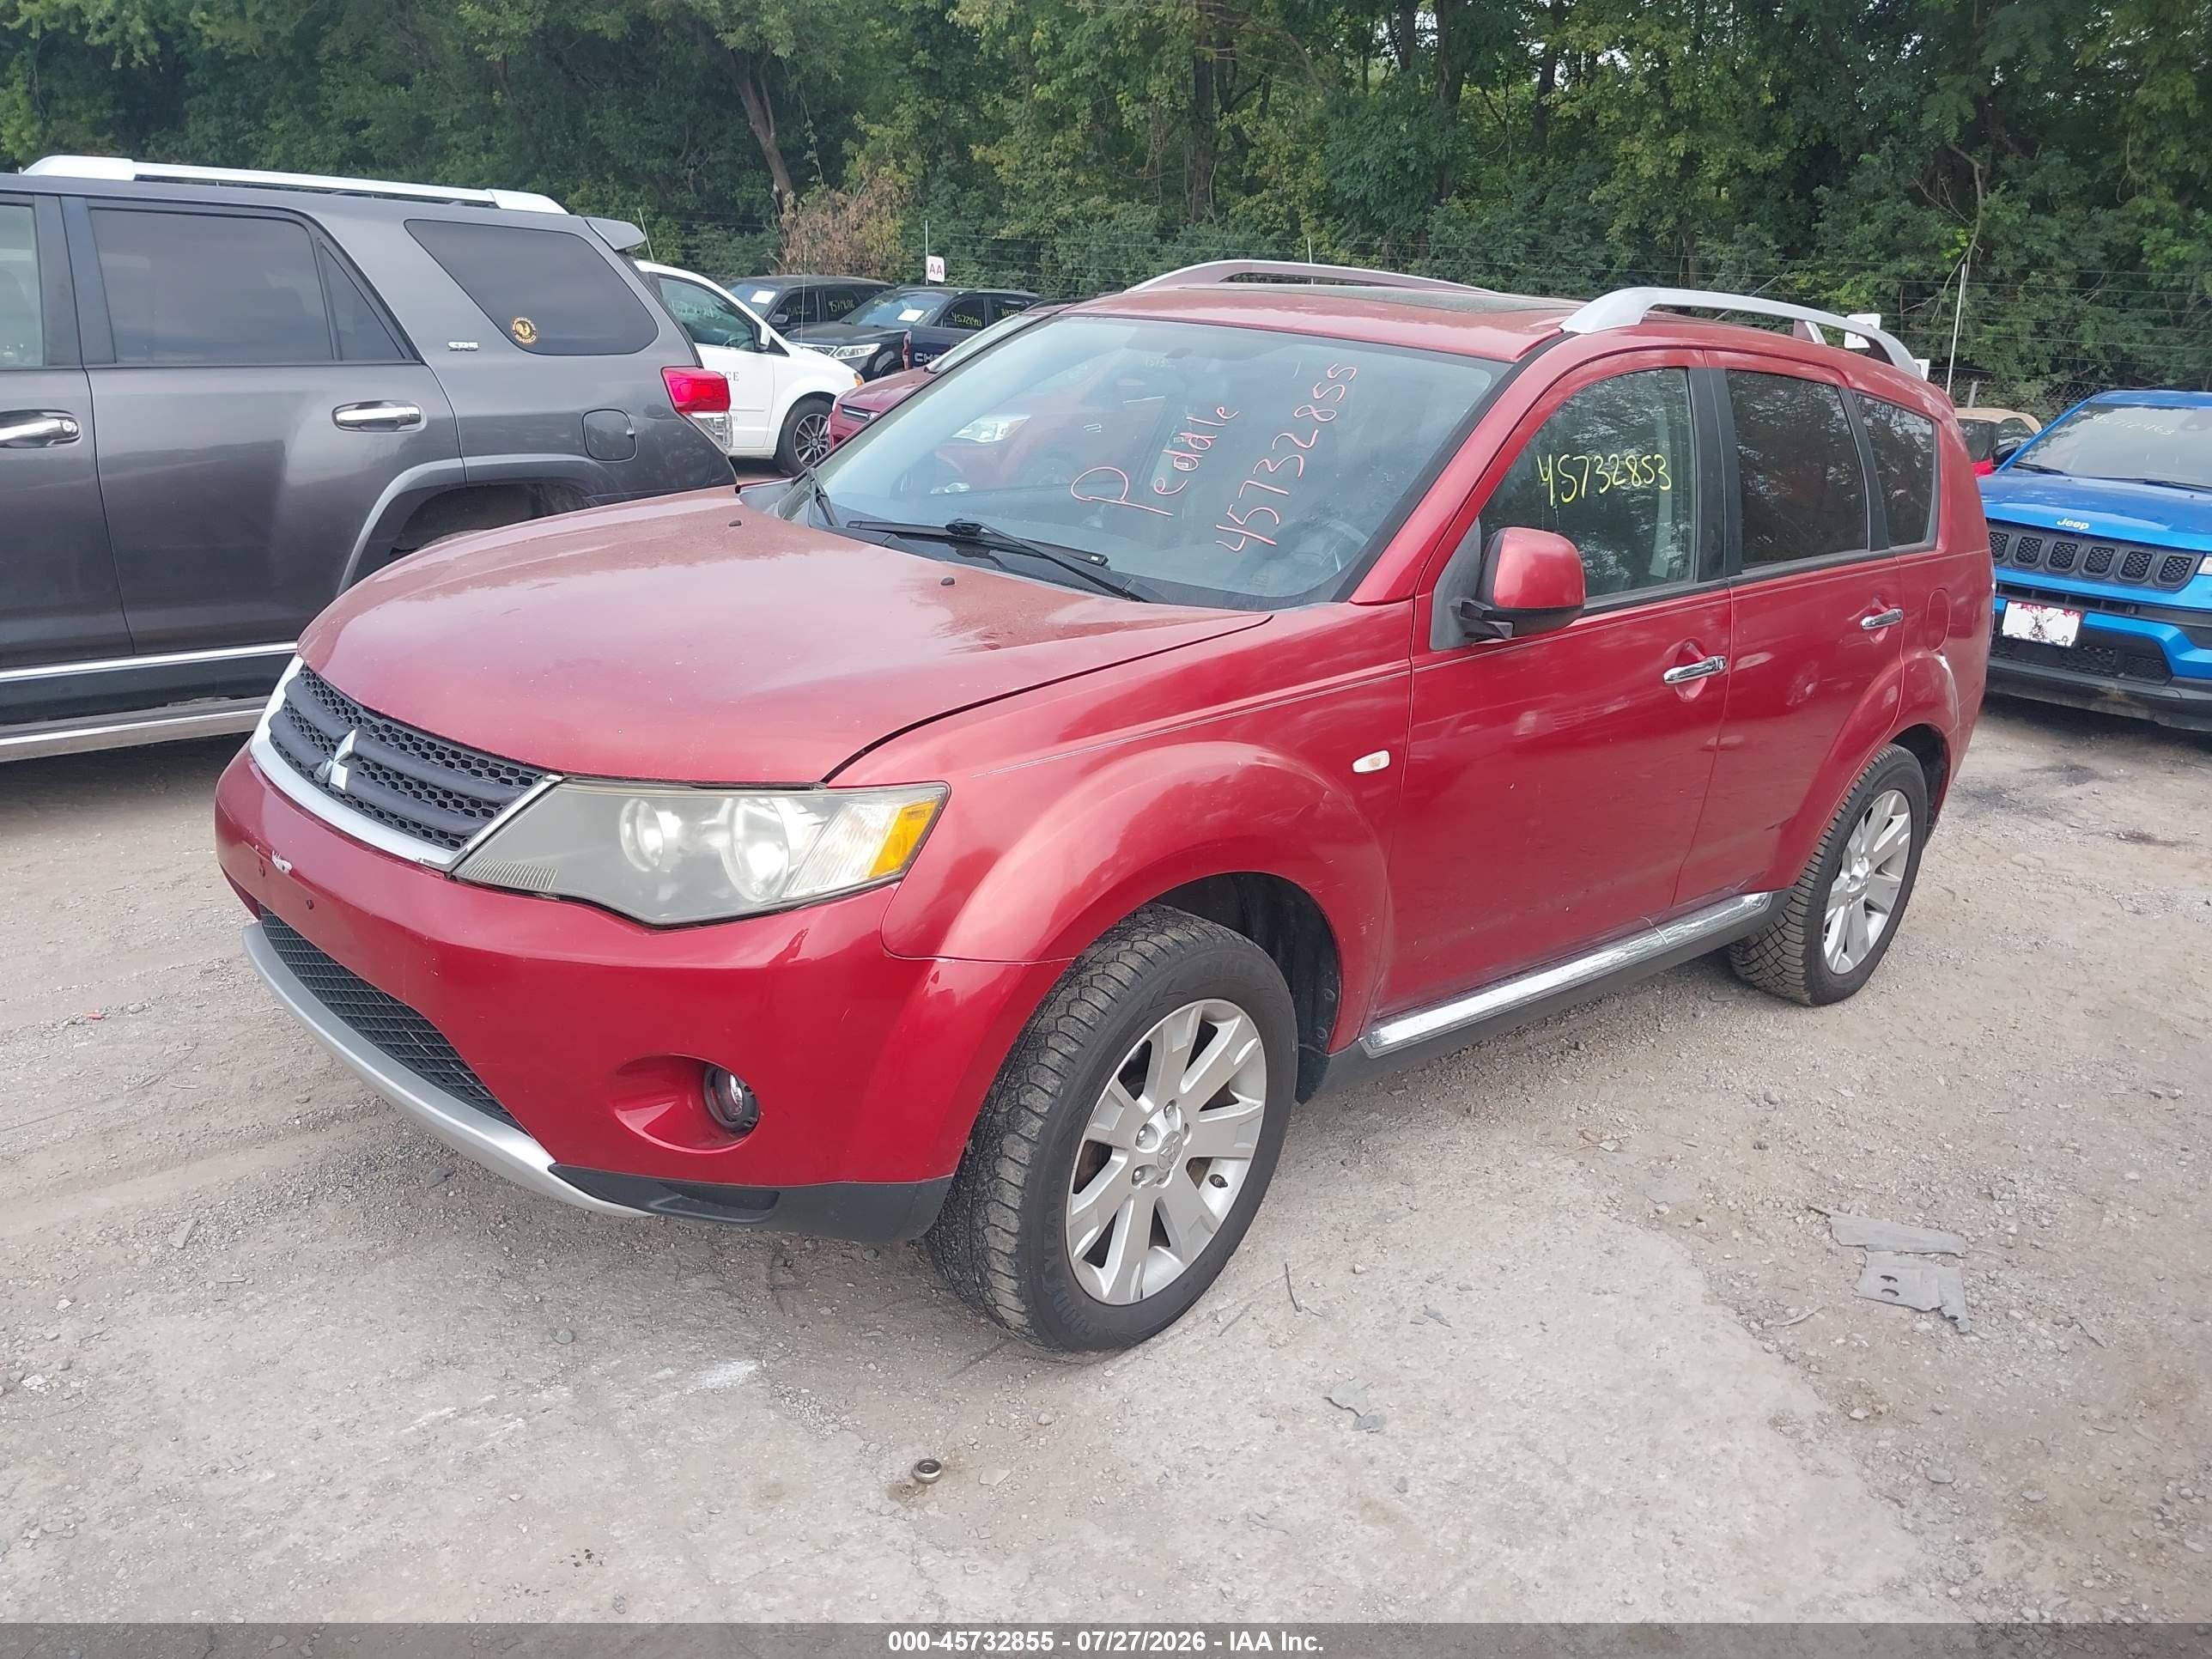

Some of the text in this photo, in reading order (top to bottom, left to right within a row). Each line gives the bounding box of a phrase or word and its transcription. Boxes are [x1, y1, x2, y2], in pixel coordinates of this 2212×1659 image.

[929, 263, 943, 276] AA
[1071, 405, 1239, 516] Peddle
[1216, 363, 1358, 551] 45732855
[2057, 518, 2089, 531] Jeep
